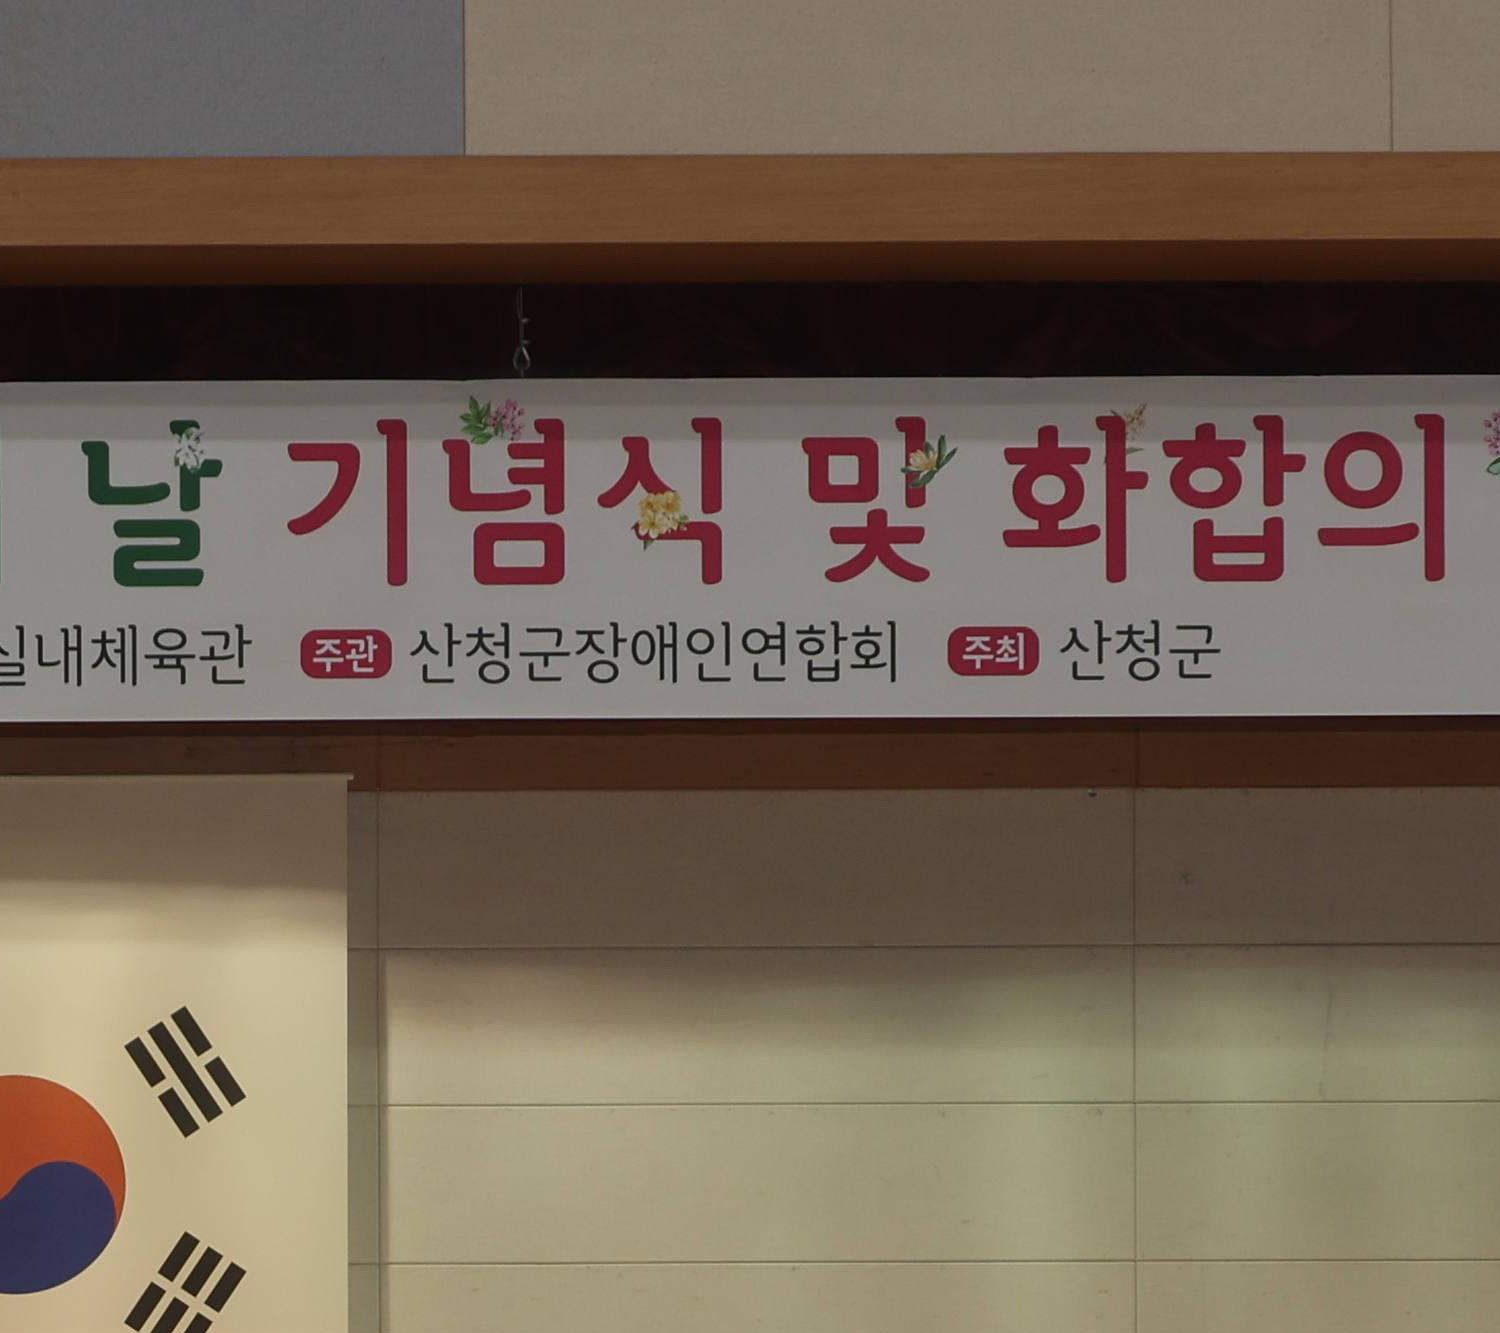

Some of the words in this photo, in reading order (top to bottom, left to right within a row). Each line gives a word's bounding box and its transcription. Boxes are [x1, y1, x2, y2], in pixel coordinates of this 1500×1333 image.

[82, 420, 222, 589] 날
[286, 416, 724, 587] 기념식
[803, 416, 934, 583] 및
[1001, 413, 1447, 585] 화합의
[310, 635, 382, 678] 주관
[408, 621, 898, 686] 산청군장애인연합회
[958, 632, 1030, 675] 주최
[1058, 620, 1222, 683] 산청군
